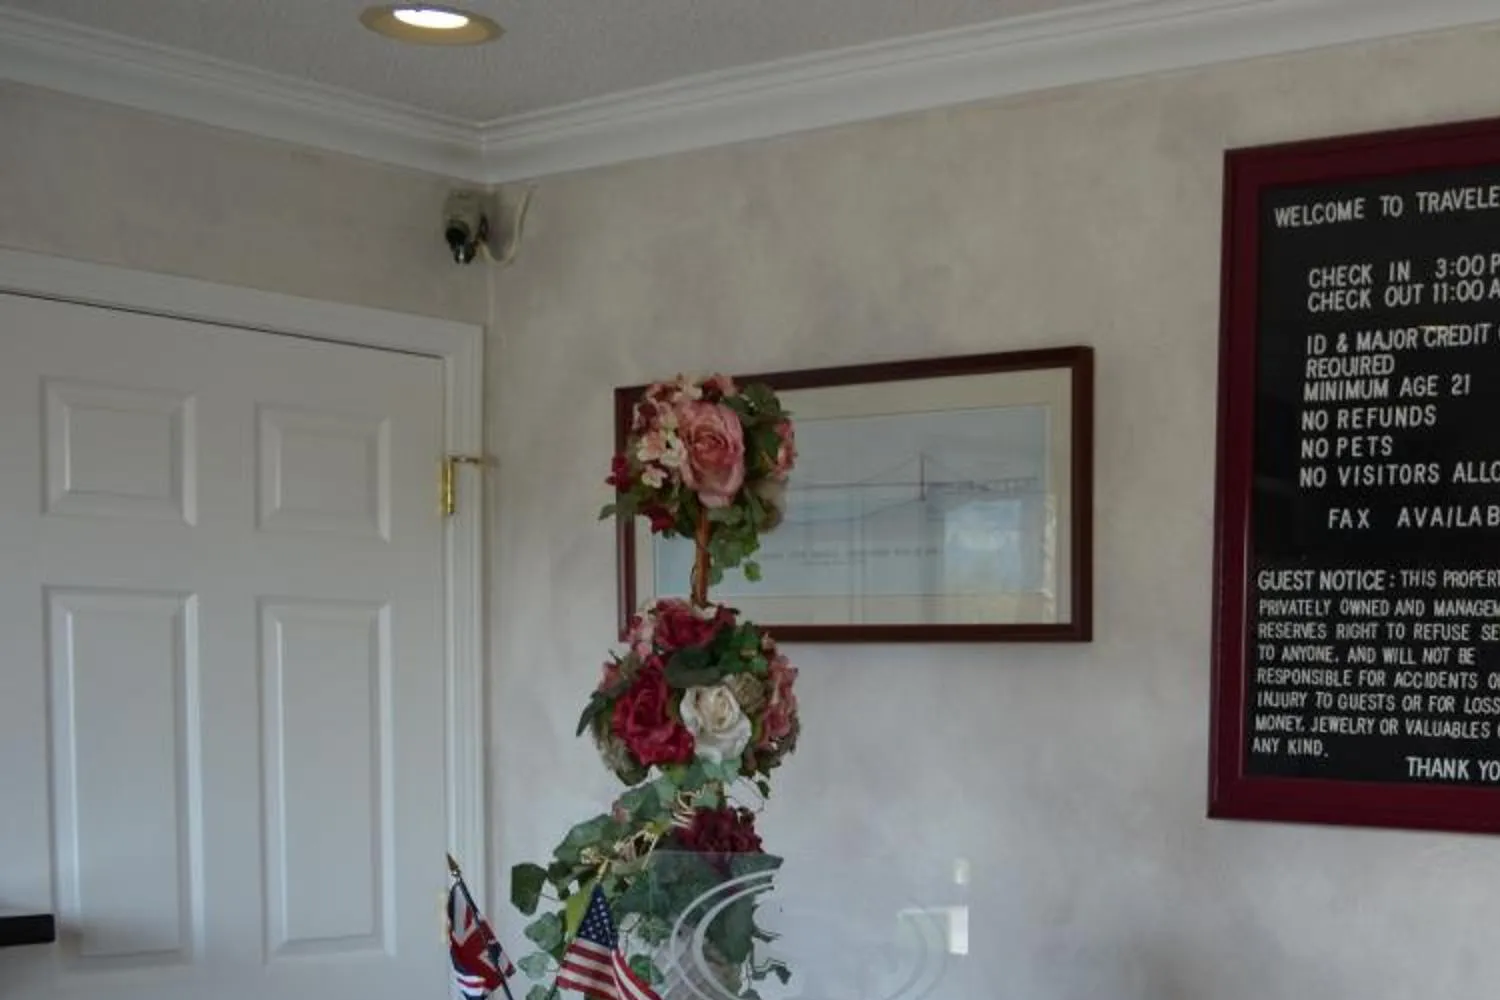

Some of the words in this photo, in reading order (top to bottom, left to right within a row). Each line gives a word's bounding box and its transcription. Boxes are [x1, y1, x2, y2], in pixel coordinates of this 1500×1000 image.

[1274, 198, 1365, 227] WELCOME
[1380, 195, 1402, 217] TO
[1309, 264, 1373, 288] CHECK
[1389, 261, 1411, 281] IN
[1435, 255, 1485, 278] 3:00
[1307, 288, 1372, 313] CHECK
[1384, 285, 1423, 307] OUT
[1432, 280, 1484, 303] 11:00
[1307, 335, 1326, 355] ID
[1336, 333, 1348, 352] &
[1356, 328, 1418, 352] MAJOR
[1423, 322, 1492, 347] CREDIT
[1305, 355, 1395, 378] REQUIRED
[1303, 379, 1389, 401] MINIMUM
[1400, 376, 1439, 397] AGE
[1451, 374, 1471, 395] 21
[1301, 410, 1328, 431] NO
[1337, 405, 1437, 429] REFUNDS
[1301, 438, 1328, 458] NO
[1337, 436, 1393, 457] PETS
[1299, 467, 1326, 488] NO
[1338, 463, 1440, 486] VISITORS
[1328, 508, 1370, 529] FAX
[1257, 570, 1316, 591] GUEST
[1401, 569, 1437, 588] THIS
[1259, 598, 1332, 616] PRIVATELY
[1339, 599, 1389, 616] OWNED
[1395, 600, 1425, 616] AND
[1258, 622, 1327, 639] RESERVES
[1335, 623, 1377, 639] RIGHT
[1387, 624, 1404, 640] TO
[1413, 624, 1470, 641] REFUSE
[1258, 645, 1274, 662] TO
[1347, 647, 1376, 664] AND
[1383, 647, 1416, 665] WILL
[1422, 647, 1449, 664] NOT
[1458, 647, 1475, 664] BE
[1257, 668, 1352, 687] RESPONSIBLE
[1359, 670, 1385, 687] FOR
[1395, 671, 1478, 689] ACCIDENTS
[1257, 691, 1307, 709] INJURY
[1315, 692, 1332, 709] TO
[1337, 693, 1395, 711] GUESTS
[1401, 694, 1421, 712] OR
[1429, 696, 1455, 712] FOR
[1463, 697, 1500, 714] LOSS
[1310, 717, 1374, 735] JEWELRY
[1379, 718, 1398, 735] OR
[1405, 719, 1490, 738] VALUABLES
[1252, 738, 1280, 754] ANY
[1406, 756, 1469, 780] THANK
